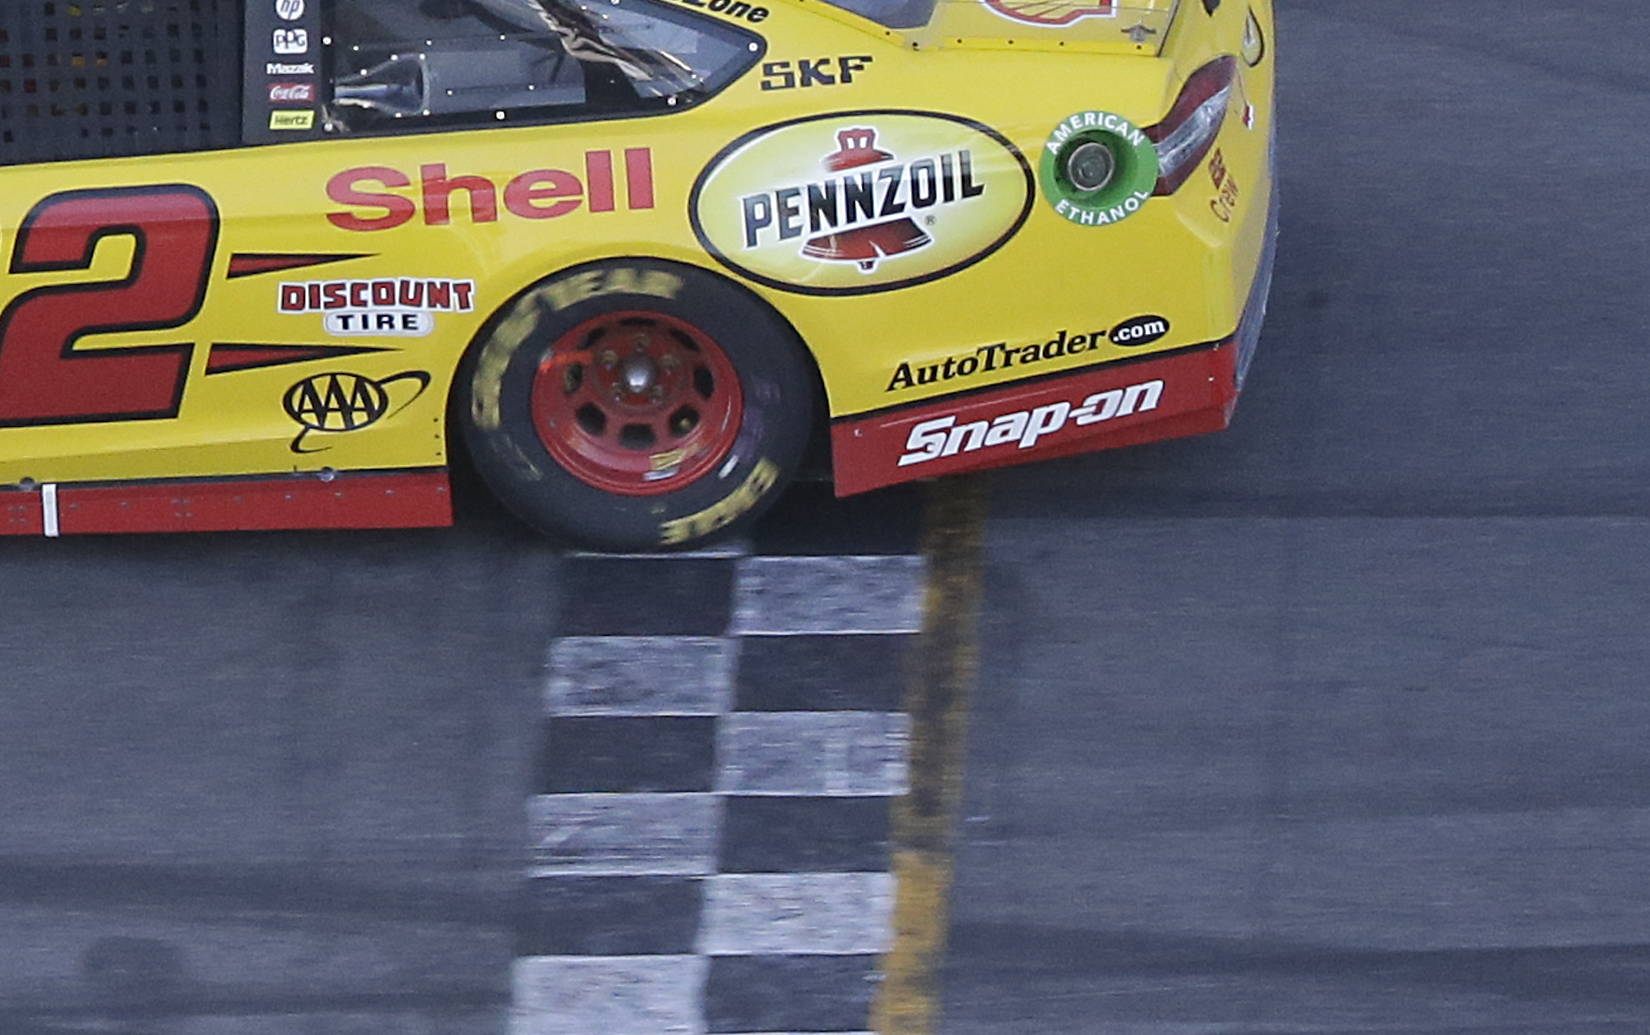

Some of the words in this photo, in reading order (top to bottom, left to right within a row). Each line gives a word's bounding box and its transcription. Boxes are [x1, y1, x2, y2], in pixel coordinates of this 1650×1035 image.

[275, 29, 306, 50] PPG
[266, 63, 315, 75] Mazak
[760, 55, 873, 92] SKF
[274, 114, 309, 126] Hertz
[1046, 112, 1146, 155] AMERICAN
[325, 146, 656, 233] Shell
[741, 149, 986, 250] PENNZOIL
[1055, 190, 1150, 225] ETHANOL
[280, 277, 473, 312] DISCOUNT
[336, 313, 419, 331] TIRE
[294, 374, 381, 430] AAA
[896, 379, 1167, 467] Snap-on
